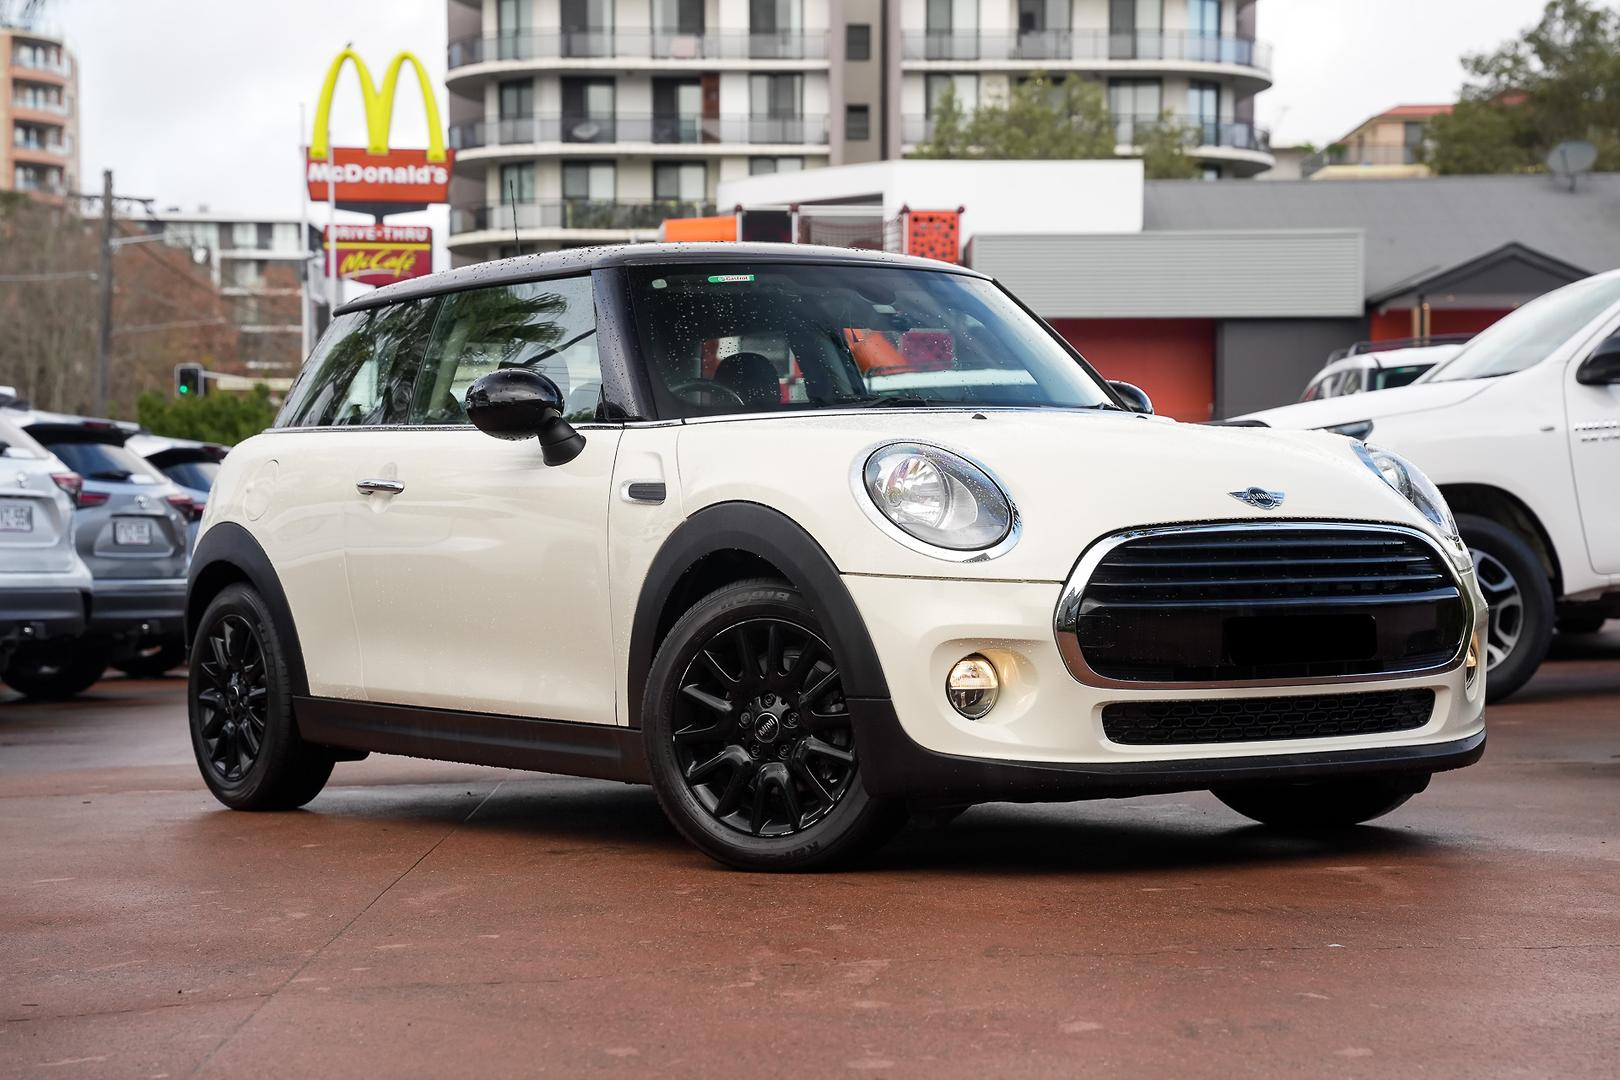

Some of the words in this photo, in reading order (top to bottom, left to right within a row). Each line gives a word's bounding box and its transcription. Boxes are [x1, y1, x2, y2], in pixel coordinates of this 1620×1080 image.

[308, 163, 448, 185] McDonald's
[333, 226, 428, 241] RIVE-THRU
[759, 718, 775, 736] MINI
